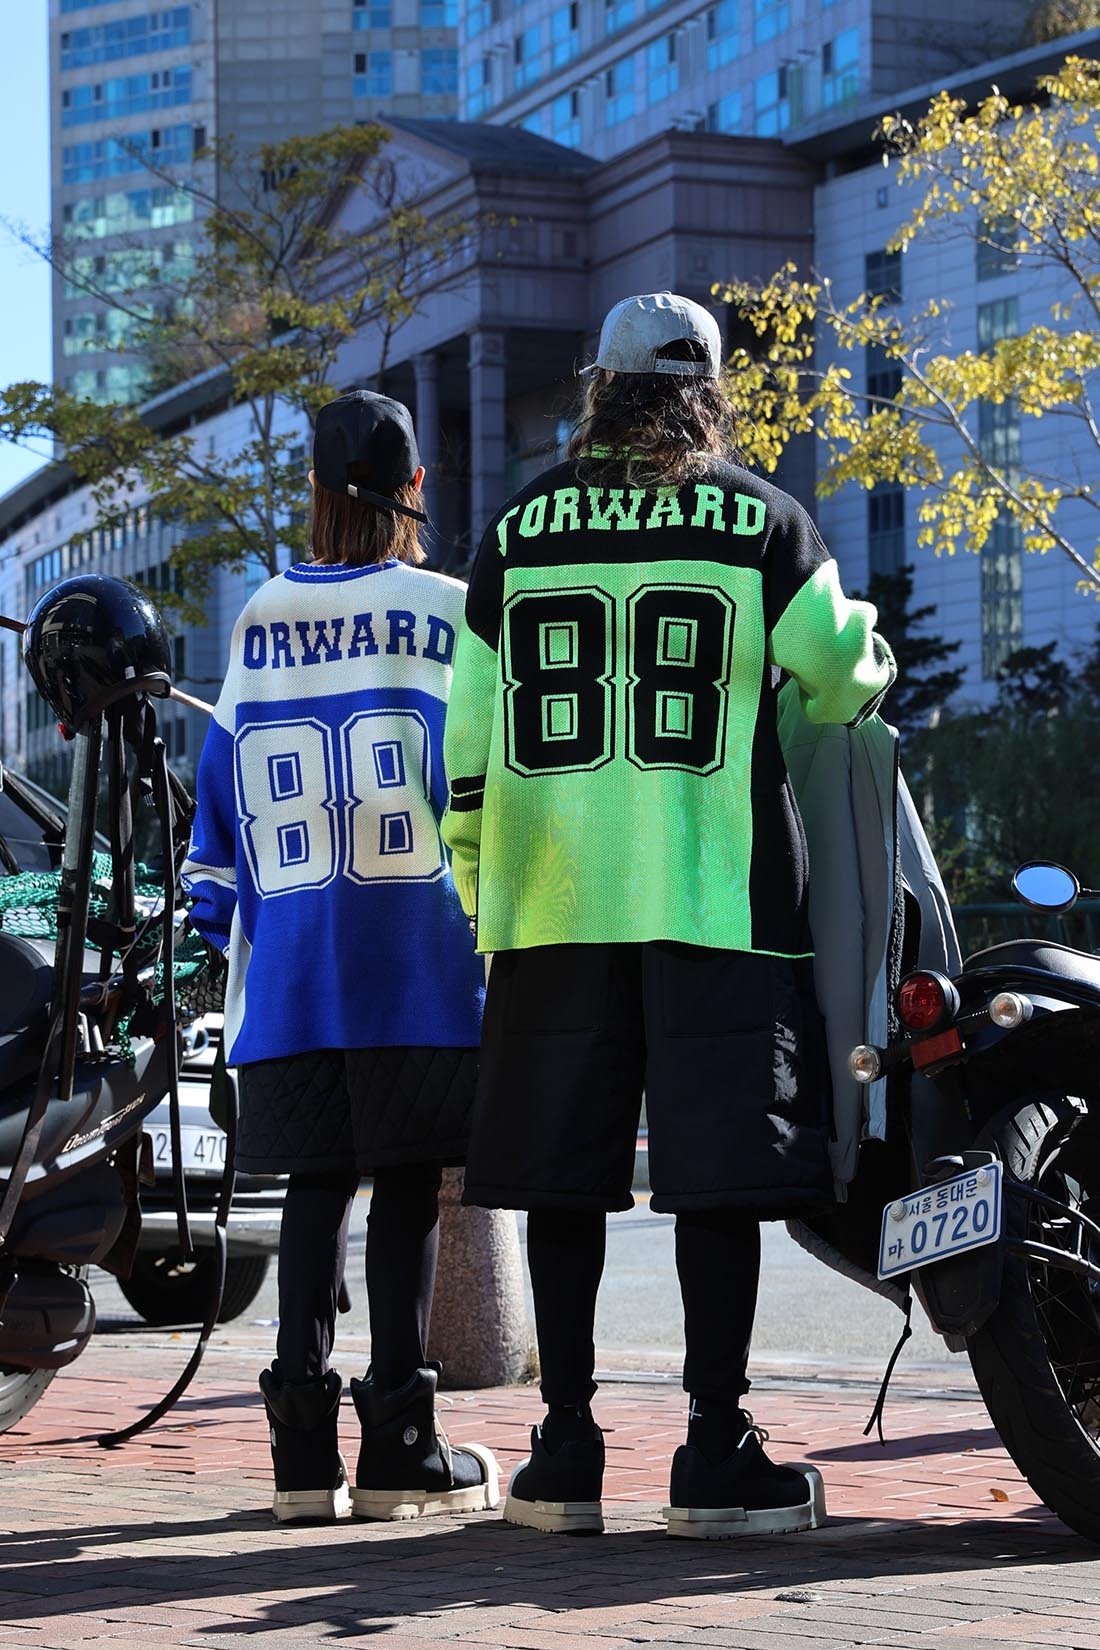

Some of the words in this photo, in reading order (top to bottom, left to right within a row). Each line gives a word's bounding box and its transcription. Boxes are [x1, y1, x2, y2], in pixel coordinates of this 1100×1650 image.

[501, 583, 737, 779] 88
[234, 708, 450, 900] 88
[888, 1238, 904, 1260] 마
[911, 1199, 989, 1254] 0720
[908, 1196, 932, 1217] 서울
[936, 1177, 978, 1209] 동대문
